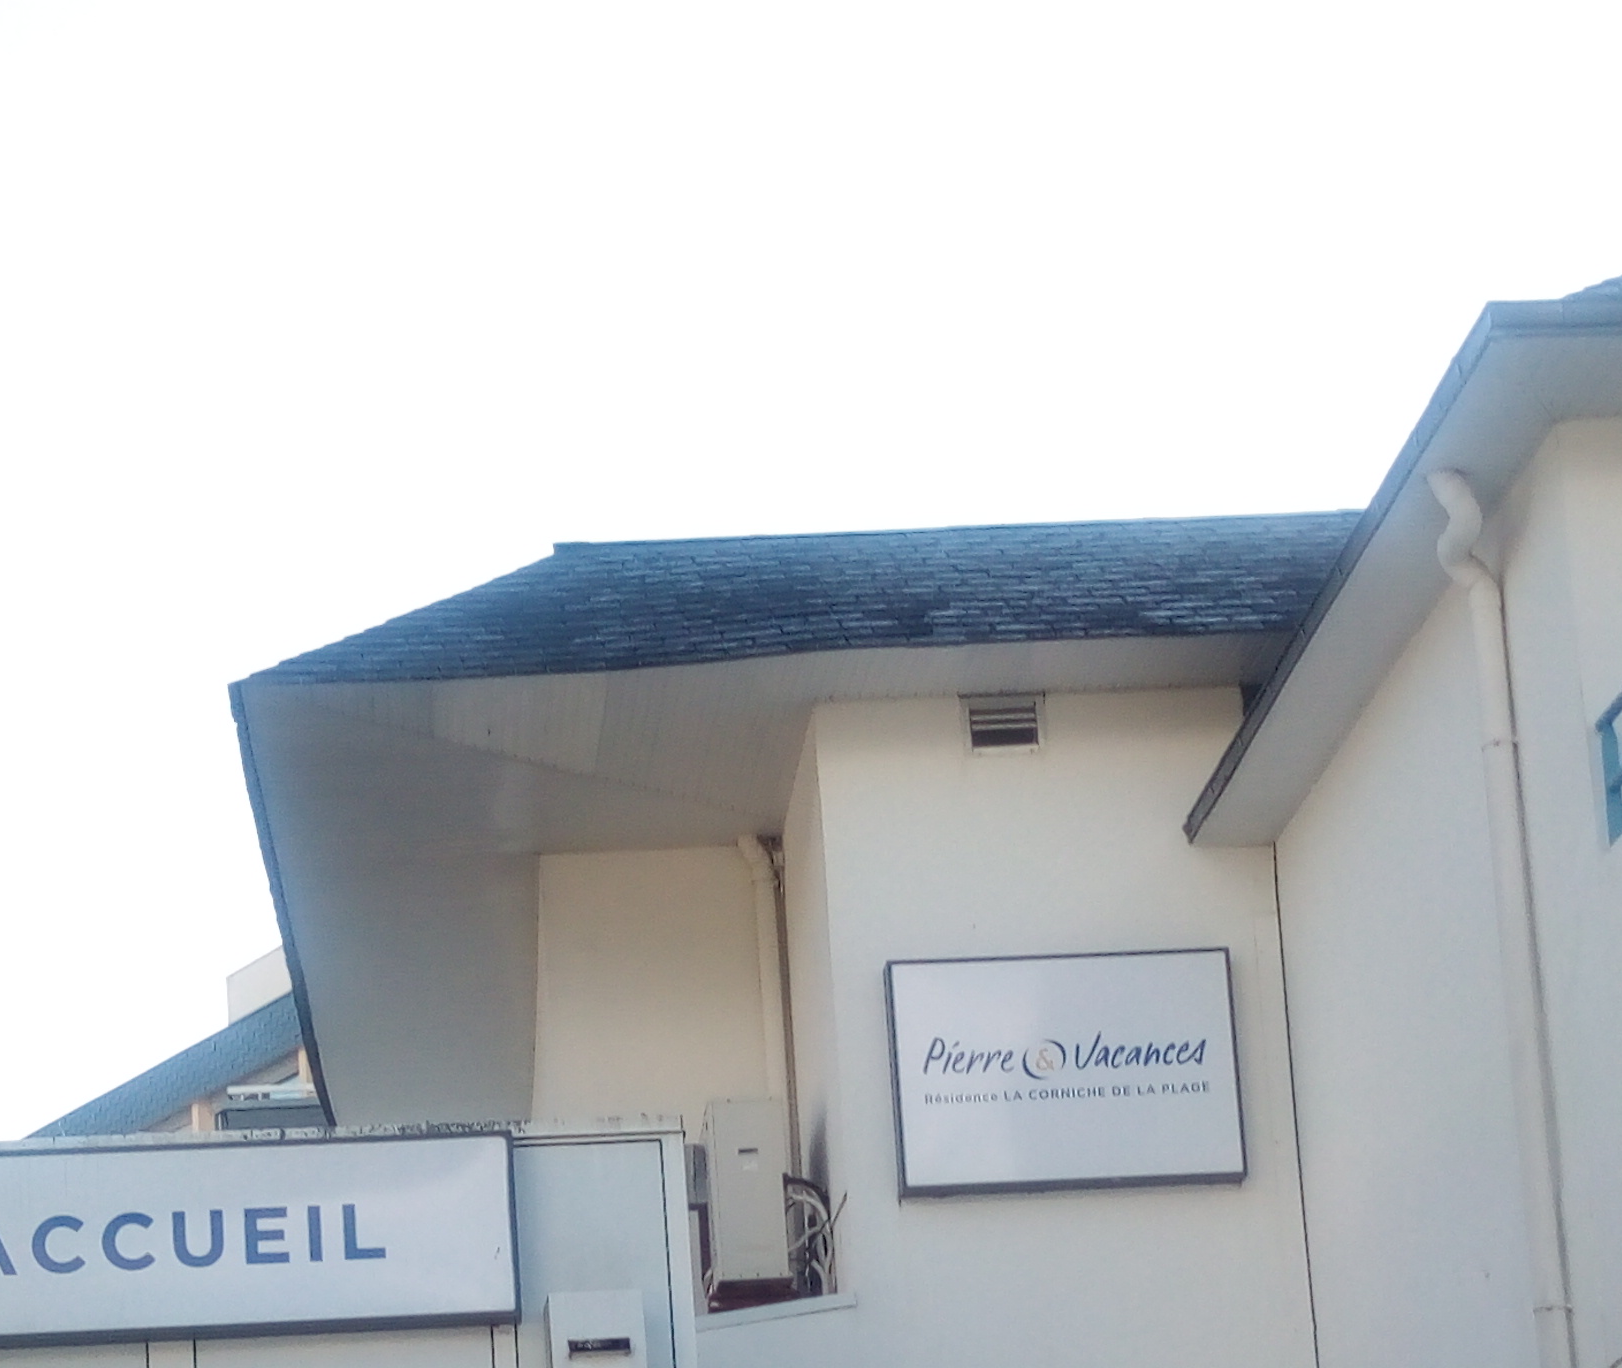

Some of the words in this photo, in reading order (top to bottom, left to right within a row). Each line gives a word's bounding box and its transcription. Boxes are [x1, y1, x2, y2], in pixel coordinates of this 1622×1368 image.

[923, 1036, 1014, 1075] Pierre
[1075, 1031, 1207, 1071] Vacances
[1003, 1090, 1024, 1102] LA
[1028, 1084, 1106, 1101] CORNICHE
[1111, 1084, 1132, 1098] DE
[1137, 1082, 1158, 1096] LA
[1161, 1080, 1211, 1095] PLAGE
